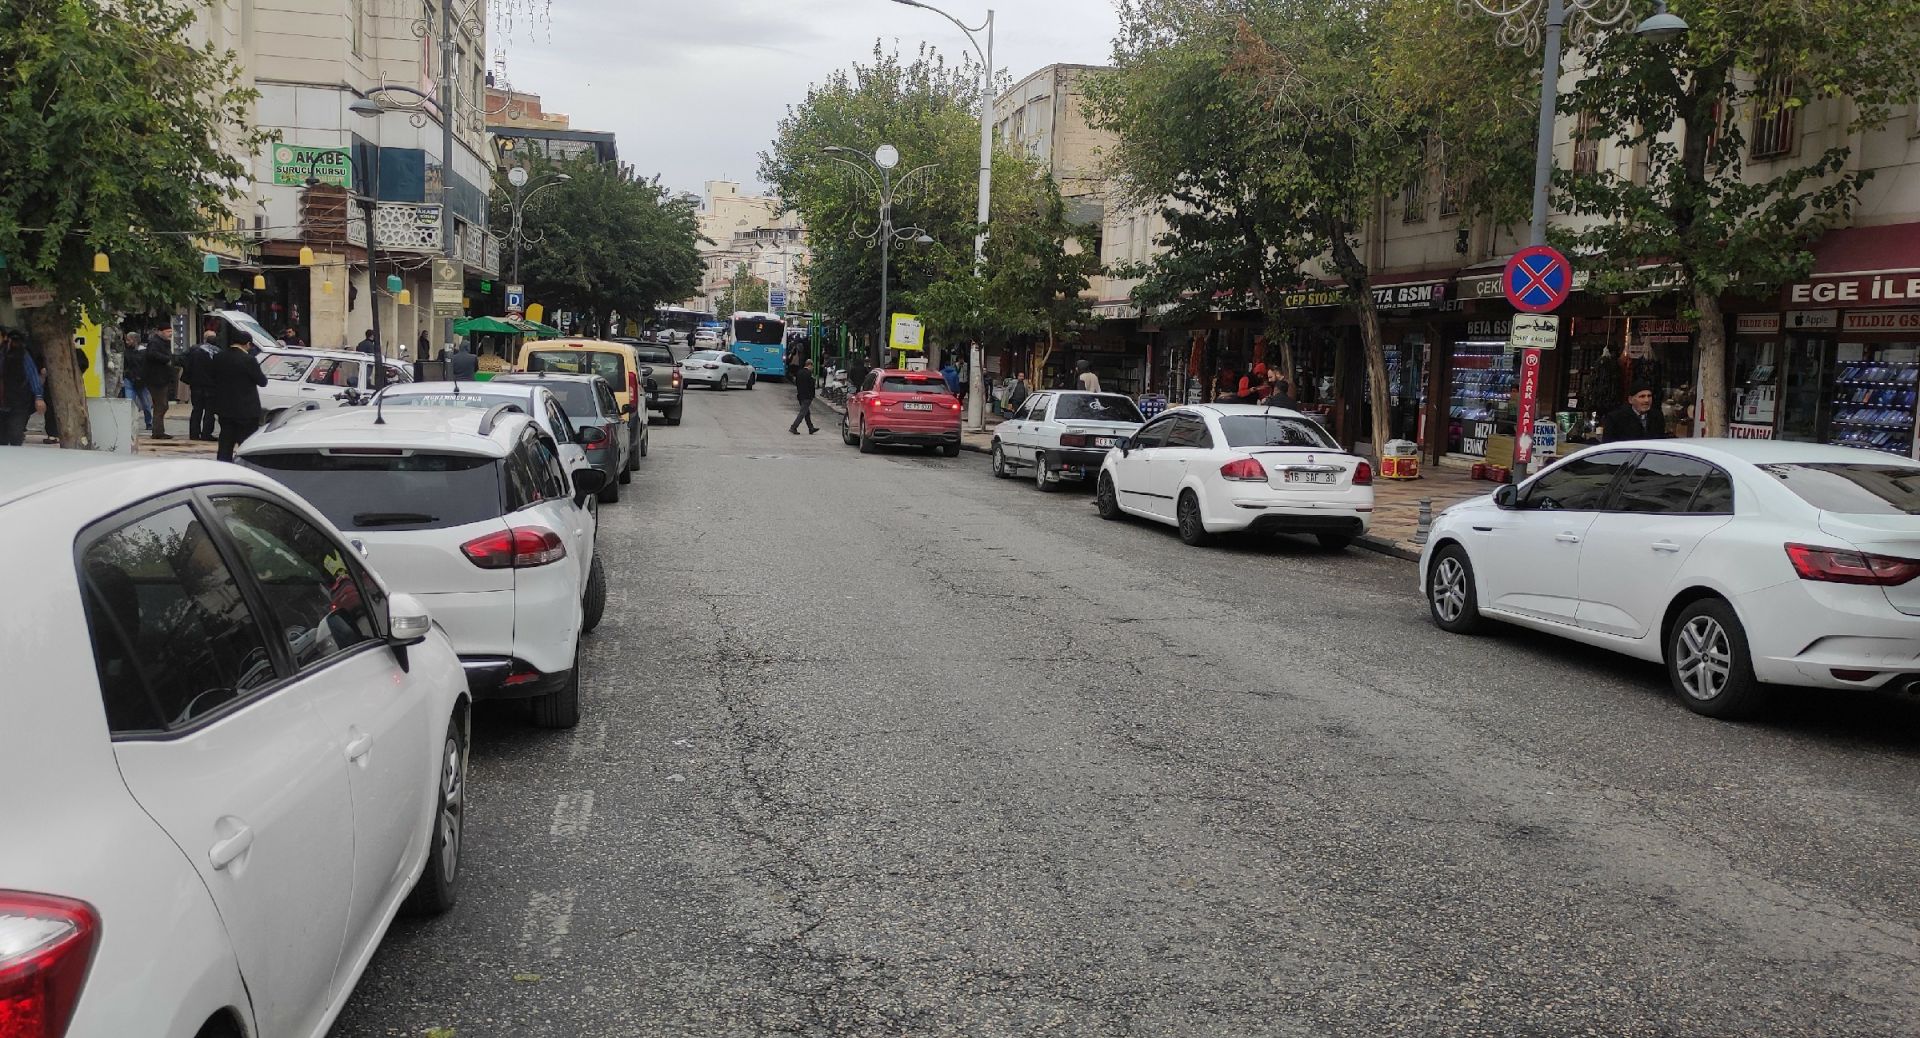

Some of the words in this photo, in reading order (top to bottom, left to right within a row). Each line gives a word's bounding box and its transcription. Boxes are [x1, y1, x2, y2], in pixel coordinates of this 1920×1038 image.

[296, 151, 344, 165] AKABE
[315, 167, 346, 175] KURSU
[1398, 285, 1433, 302] GSM
[1791, 281, 1859, 302] EGE
[1467, 320, 1491, 334] BETA
[1805, 314, 1829, 326] Apple
[1848, 314, 1896, 327] YILDIZ
[1524, 370, 1534, 399] PARK
[1290, 472, 1299, 482] 16
